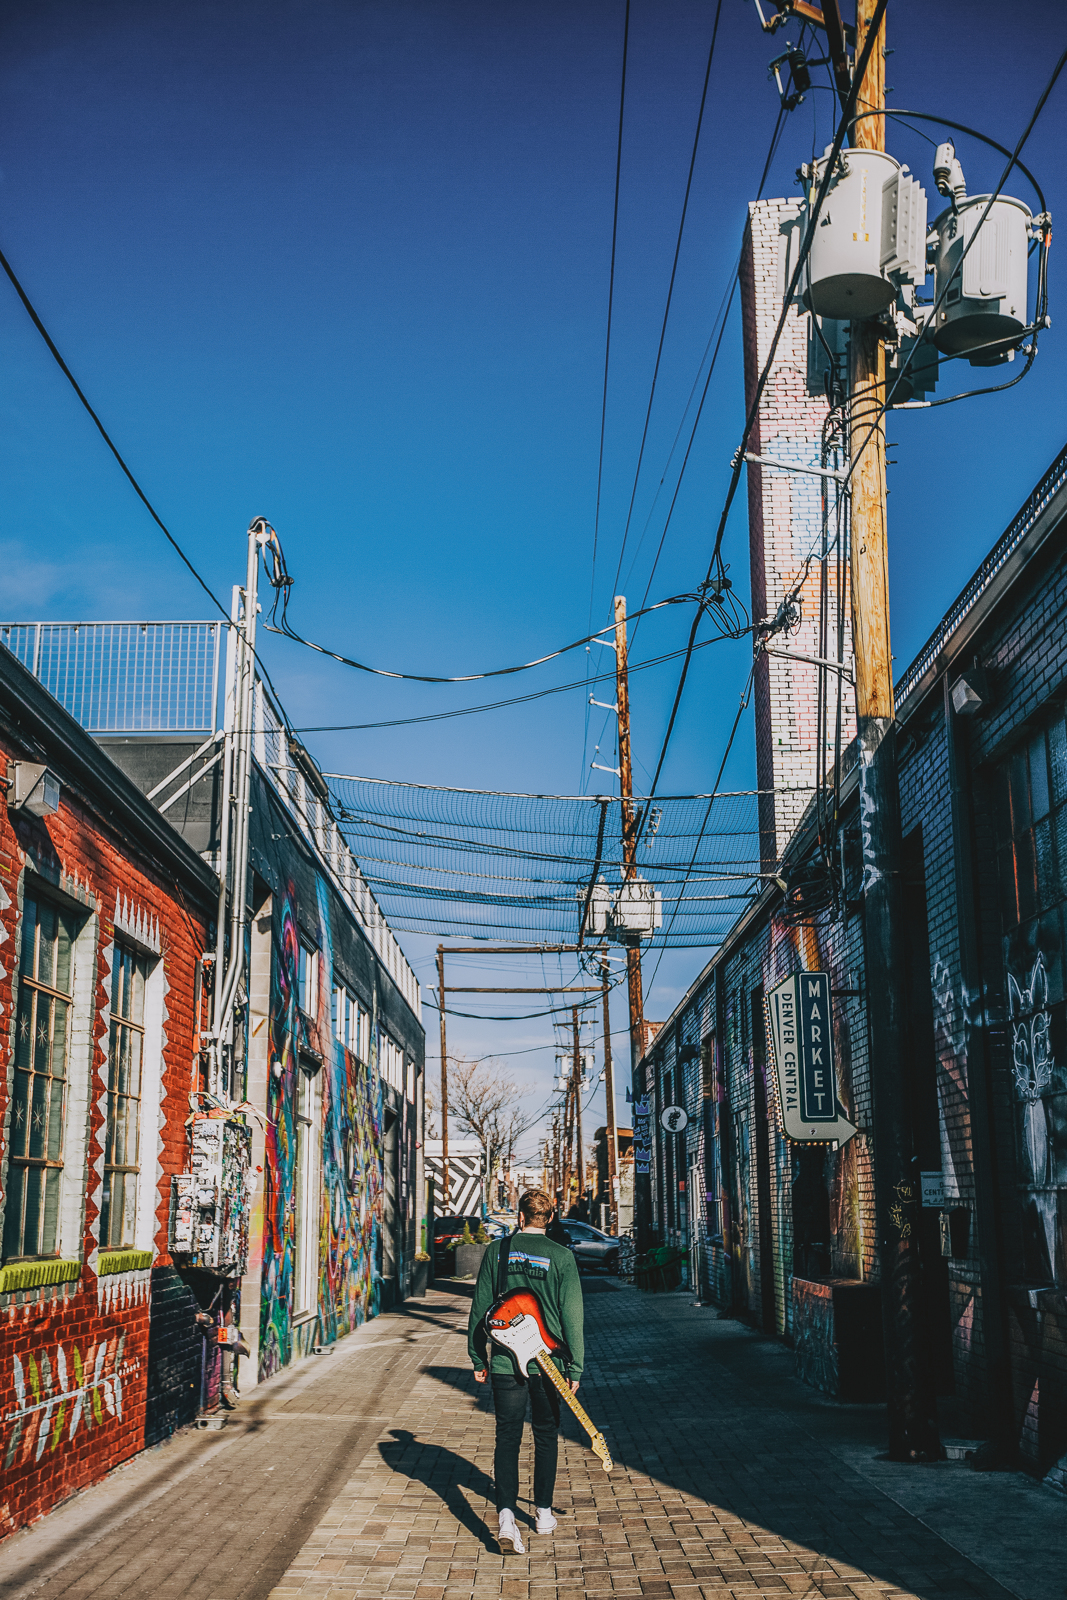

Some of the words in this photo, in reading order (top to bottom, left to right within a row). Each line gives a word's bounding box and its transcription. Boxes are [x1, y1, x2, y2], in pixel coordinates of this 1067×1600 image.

[781, 993, 794, 1044] DENVER
[808, 980, 825, 1111] MARKET
[784, 1051, 797, 1112] CENTRAL
